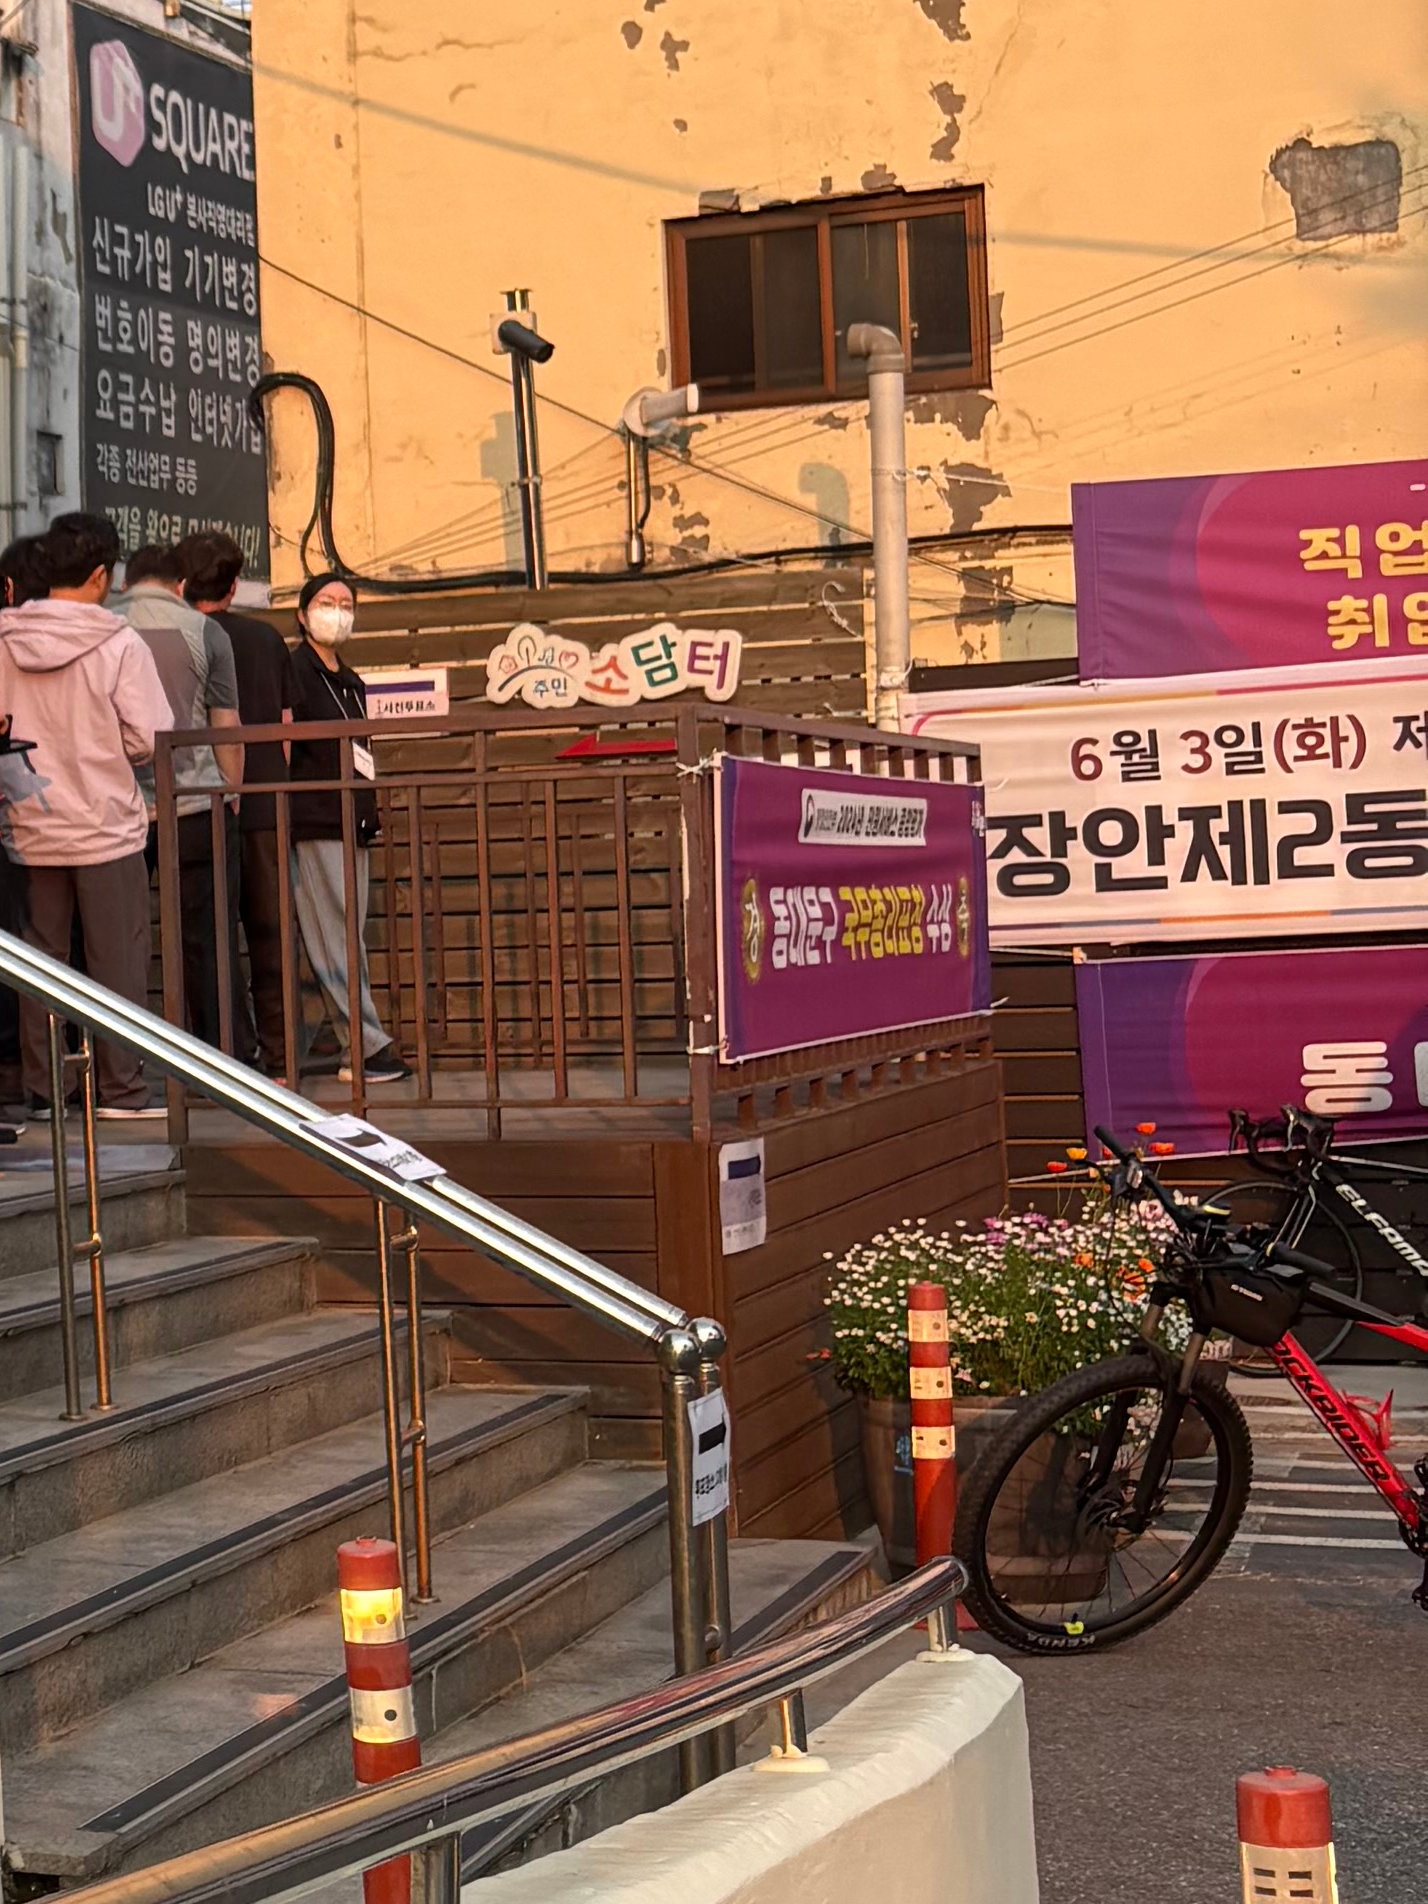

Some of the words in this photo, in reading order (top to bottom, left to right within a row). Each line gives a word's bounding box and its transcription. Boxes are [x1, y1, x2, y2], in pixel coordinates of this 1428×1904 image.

[148, 82, 256, 183] SQUARE
[147, 182, 183, 222] LGU+
[92, 216, 173, 293] 신규가입
[184, 245, 258, 317] 기기변경
[95, 293, 176, 368] 번호이동
[187, 320, 261, 389] 명의변경
[96, 369, 177, 438] 요금수납
[96, 443, 121, 483] 각종
[125, 448, 172, 491] 전산업무
[532, 678, 568, 698] 주민
[585, 634, 731, 696] 소담터
[1070, 728, 1162, 783] 6월
[1179, 713, 1368, 775] 3일(화)
[988, 788, 1428, 898] 장안제2동
[768, 885, 838, 969] 동대문구
[838, 883, 926, 961] 국무총리표창
[926, 882, 953, 954] 수상
[1300, 1041, 1428, 1115] 동
[1272, 1339, 1391, 1482] OCKRIDER
